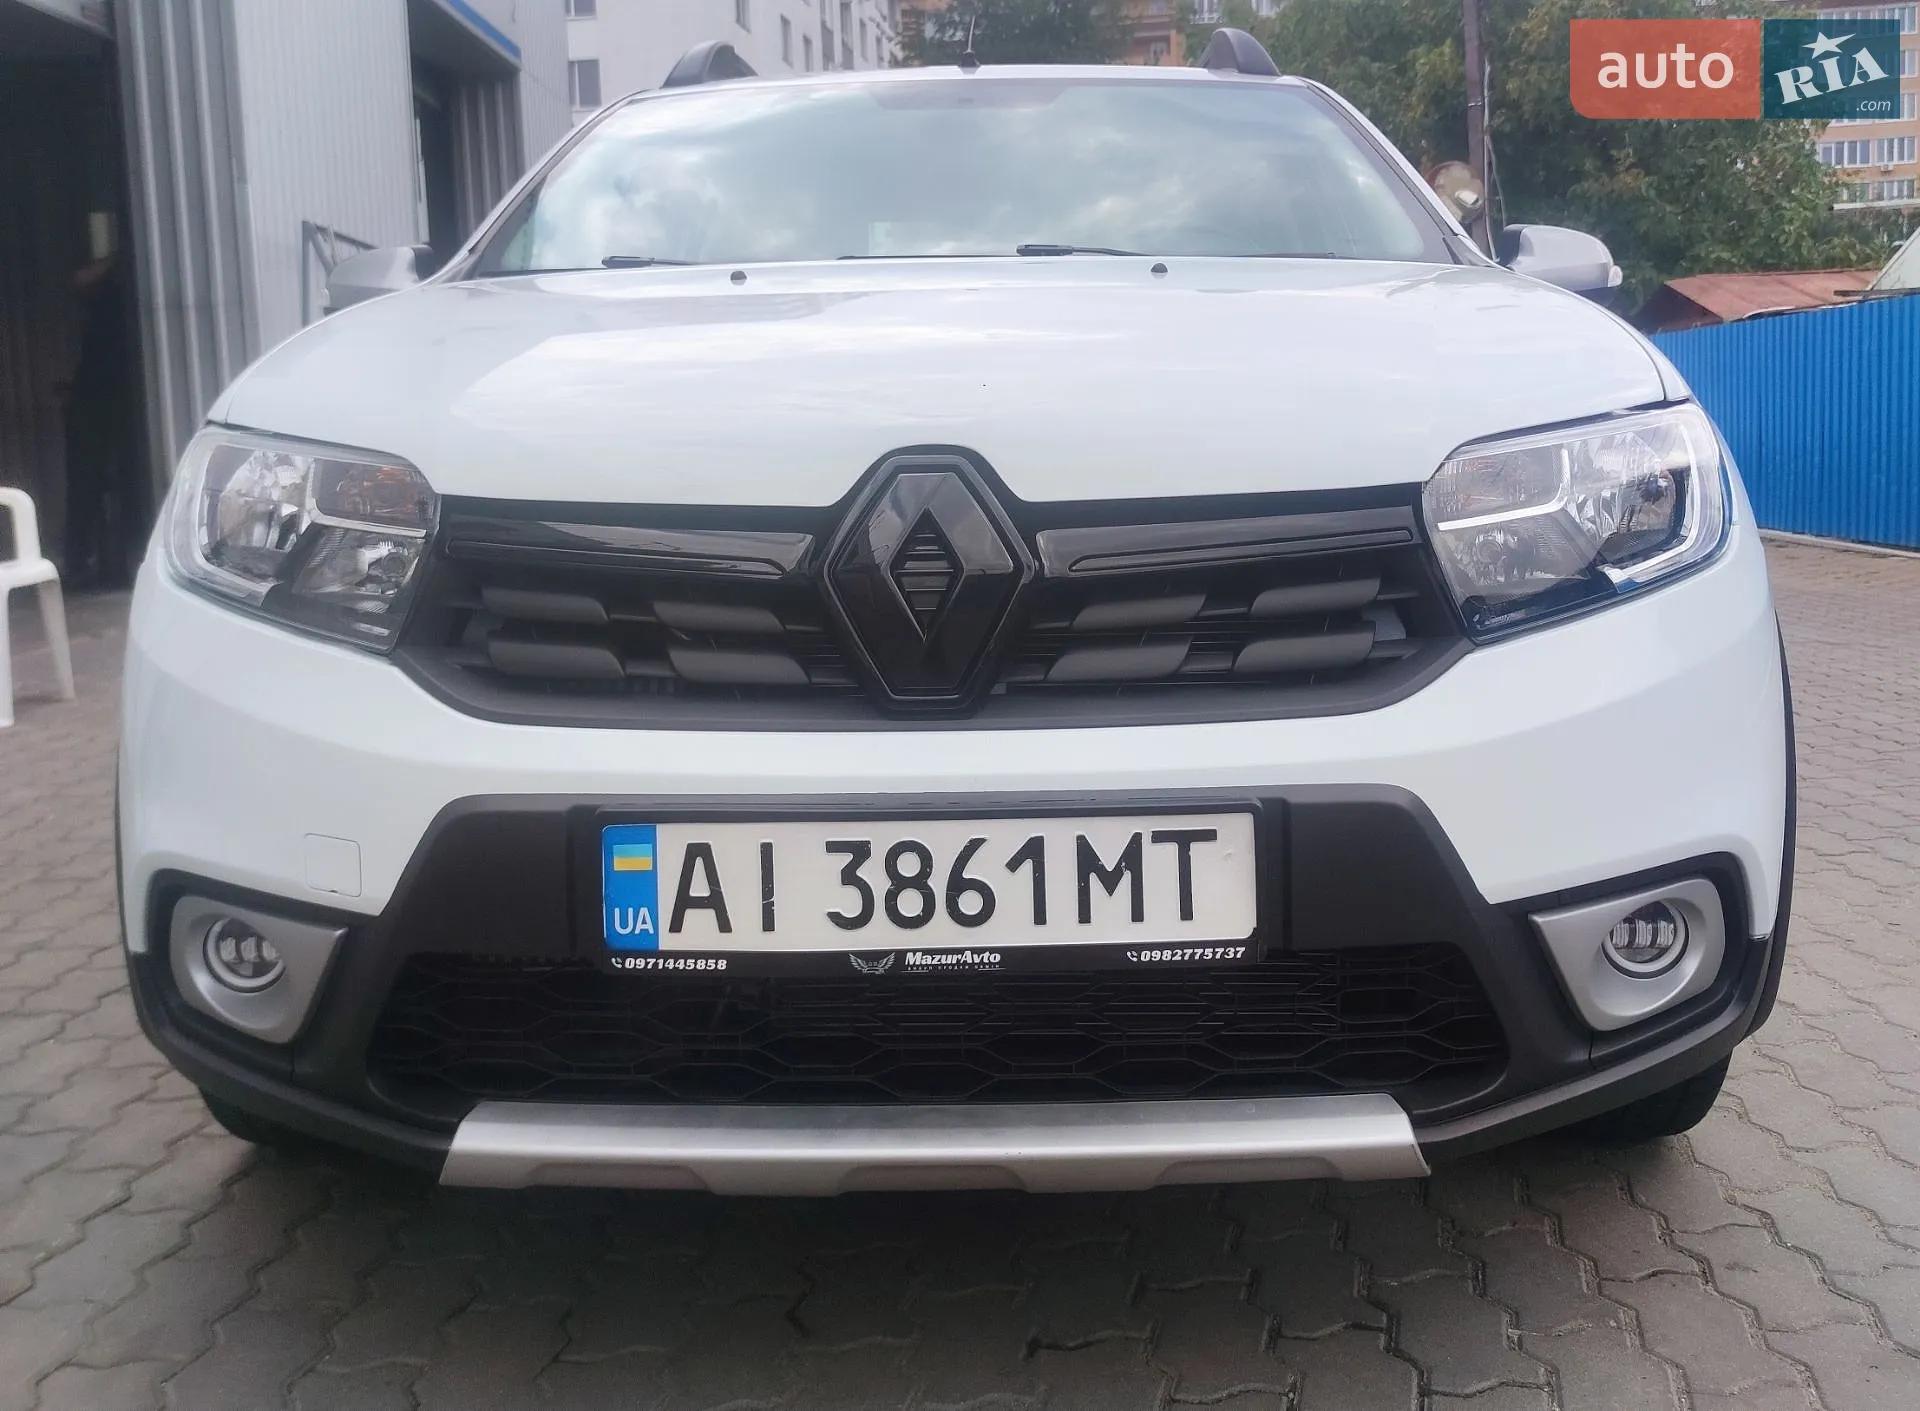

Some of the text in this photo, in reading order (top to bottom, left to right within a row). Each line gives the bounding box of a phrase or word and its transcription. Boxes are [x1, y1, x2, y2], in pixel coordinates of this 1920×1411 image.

[668, 828, 1219, 934] AI 3861 MT
[614, 906, 655, 935] UA
[905, 950, 1001, 965] MazurAvto
[1140, 947, 1246, 961] 0982775737
[624, 957, 727, 970] 0971445858
